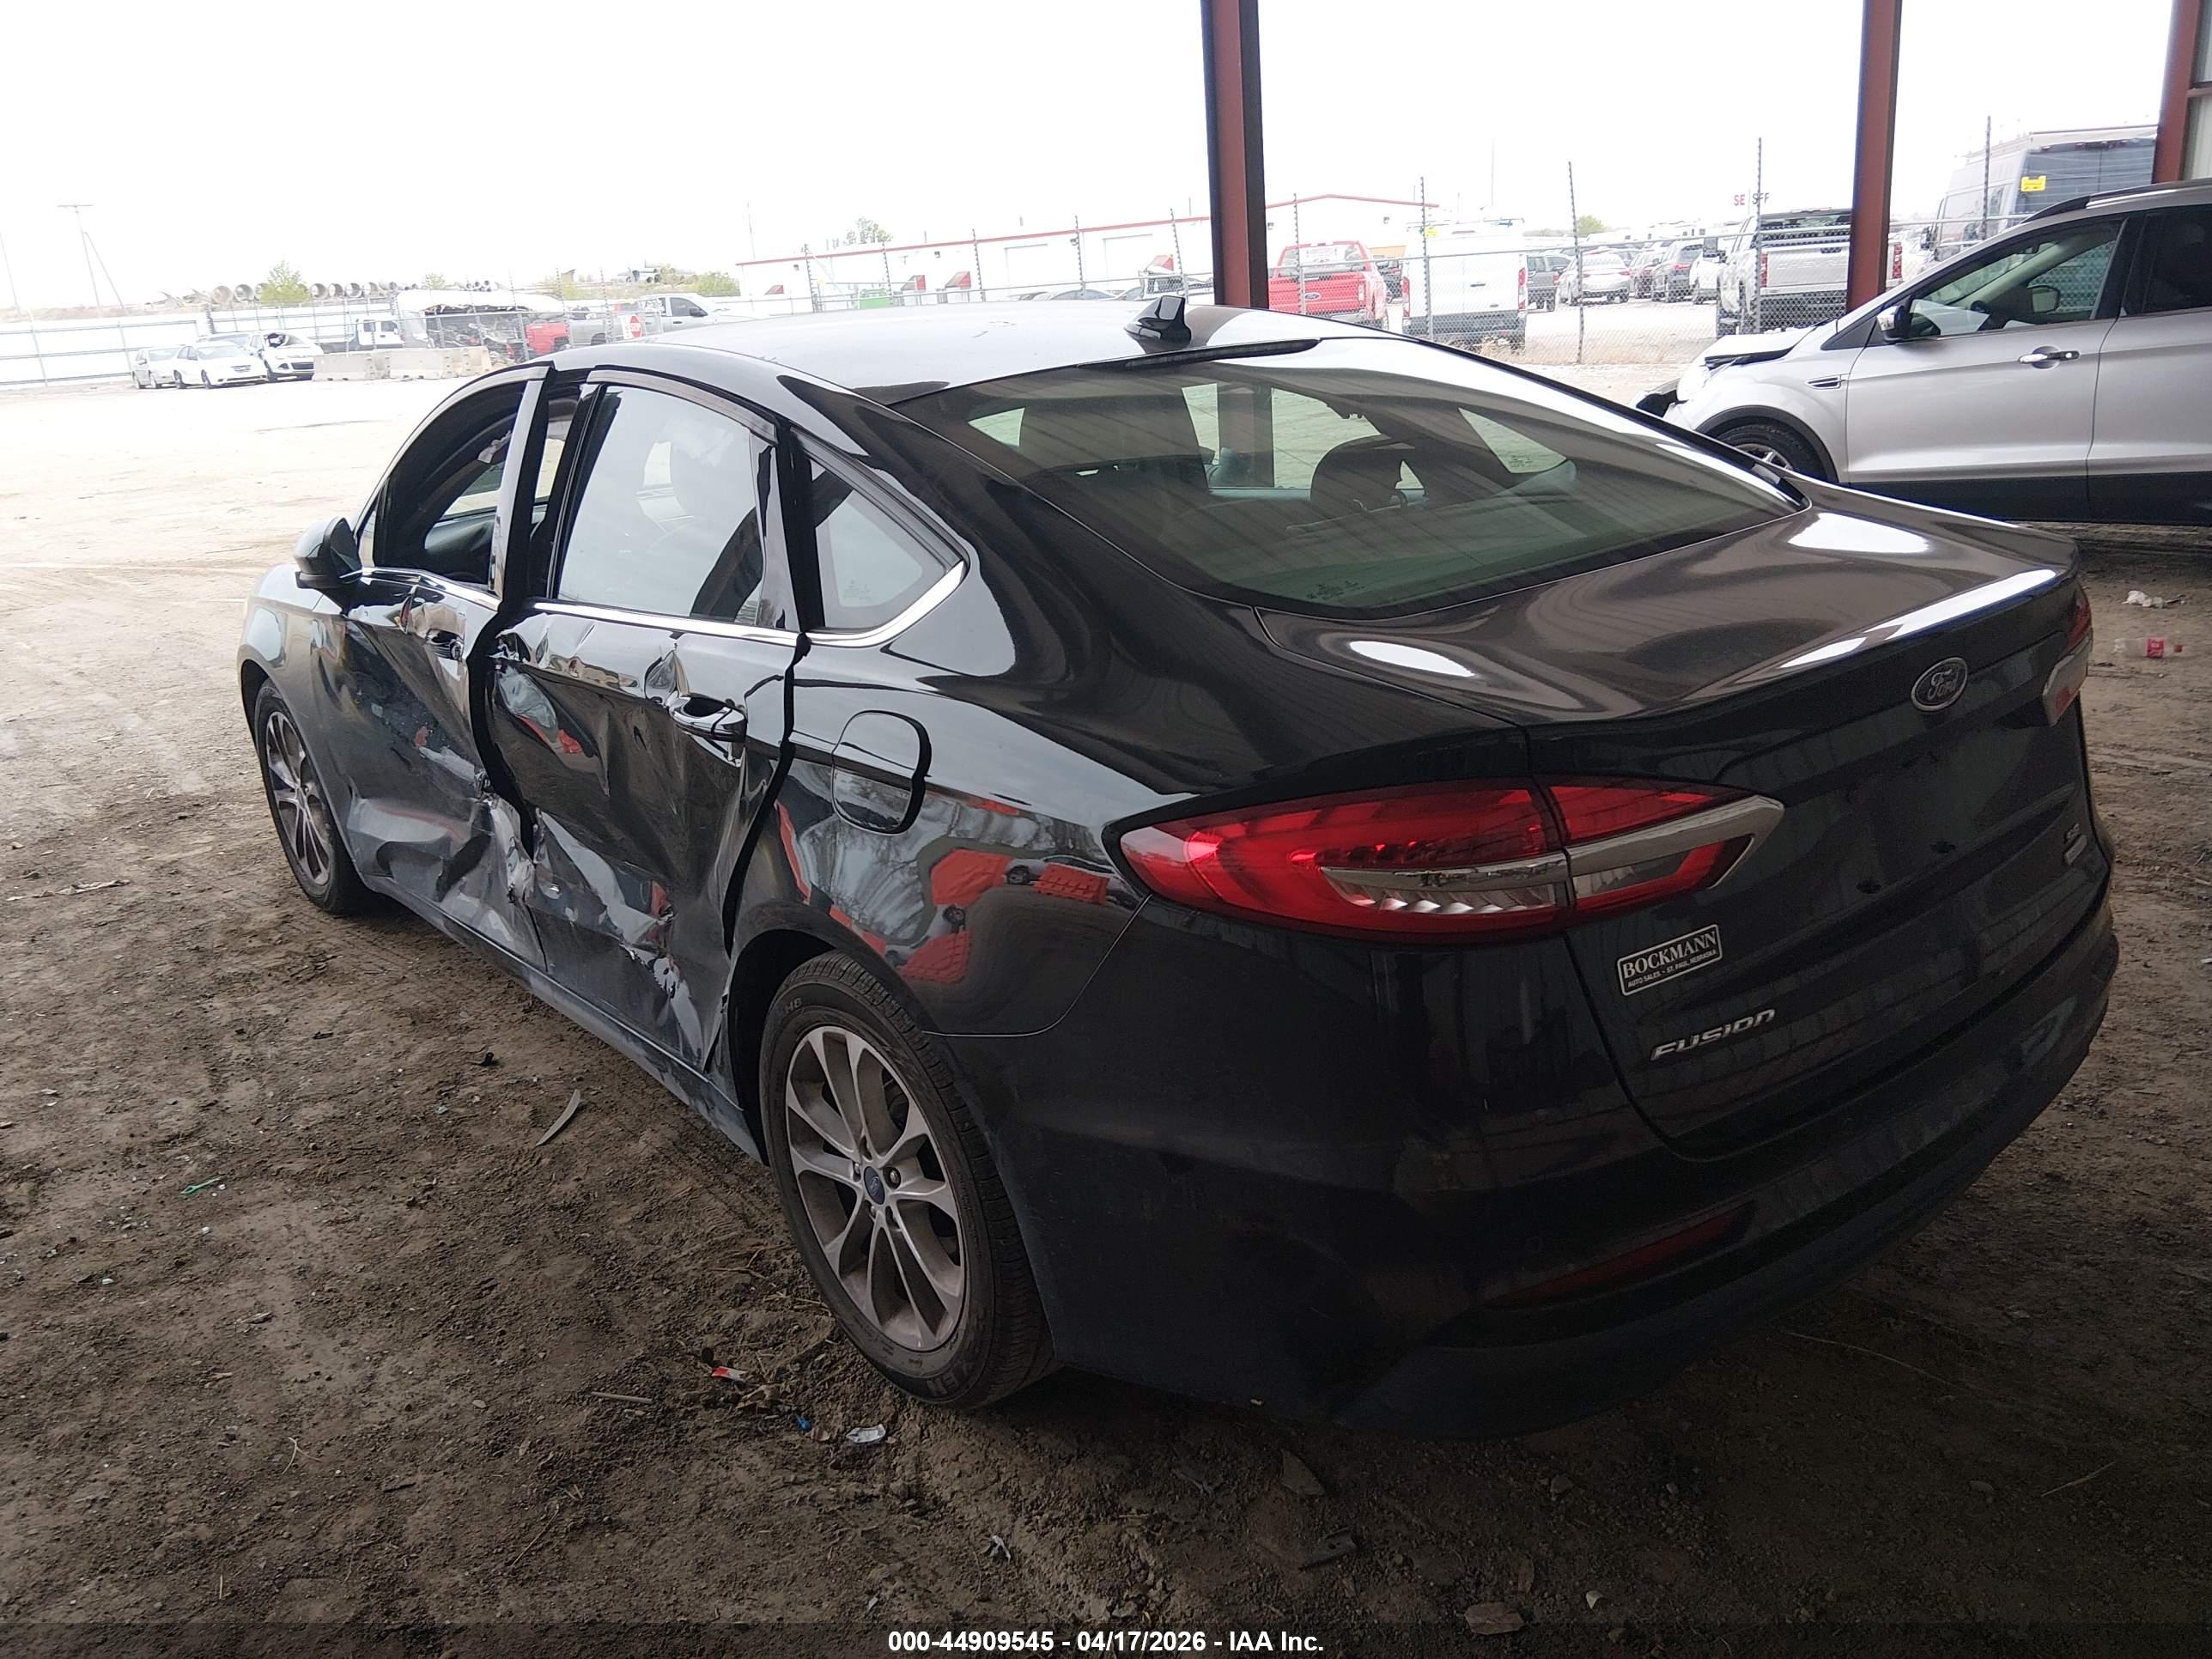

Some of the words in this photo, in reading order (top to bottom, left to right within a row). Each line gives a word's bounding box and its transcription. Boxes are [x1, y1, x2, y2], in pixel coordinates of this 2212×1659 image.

[1622, 930, 1717, 980] BOCKMANN
[1627, 976, 1644, 988] AUTO
[1644, 969, 1662, 982] SALES
[1649, 1008, 1776, 1061] FUSION
